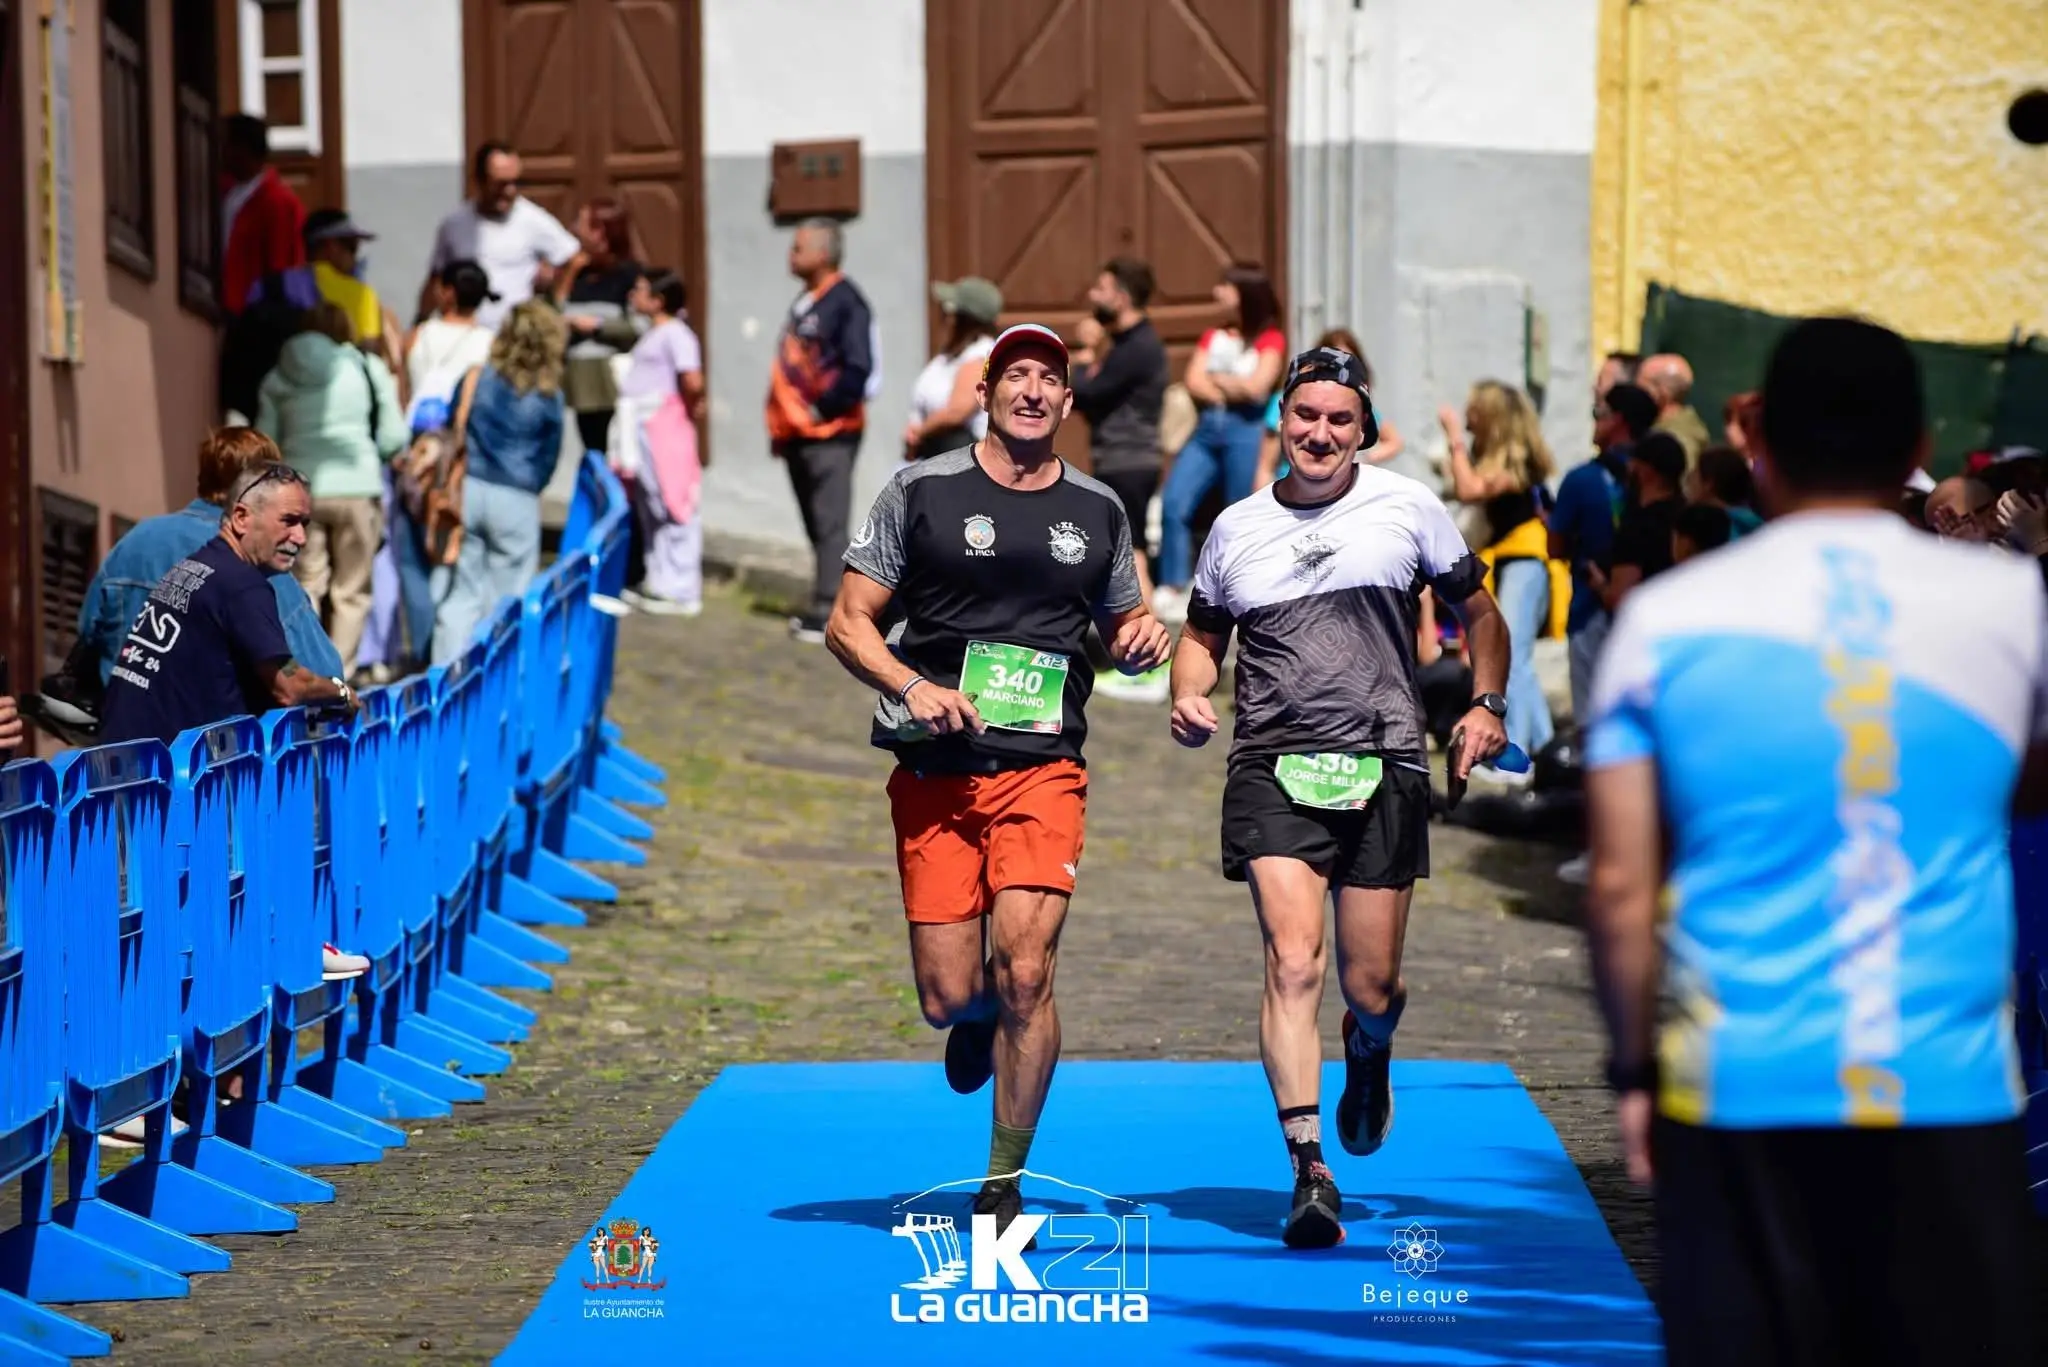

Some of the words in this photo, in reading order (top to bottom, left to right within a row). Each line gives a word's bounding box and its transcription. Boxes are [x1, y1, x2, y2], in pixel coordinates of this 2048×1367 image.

[987, 664, 1043, 694] 340
[982, 689, 1045, 708] MARCIANO
[1286, 768, 1328, 785] JORGE
